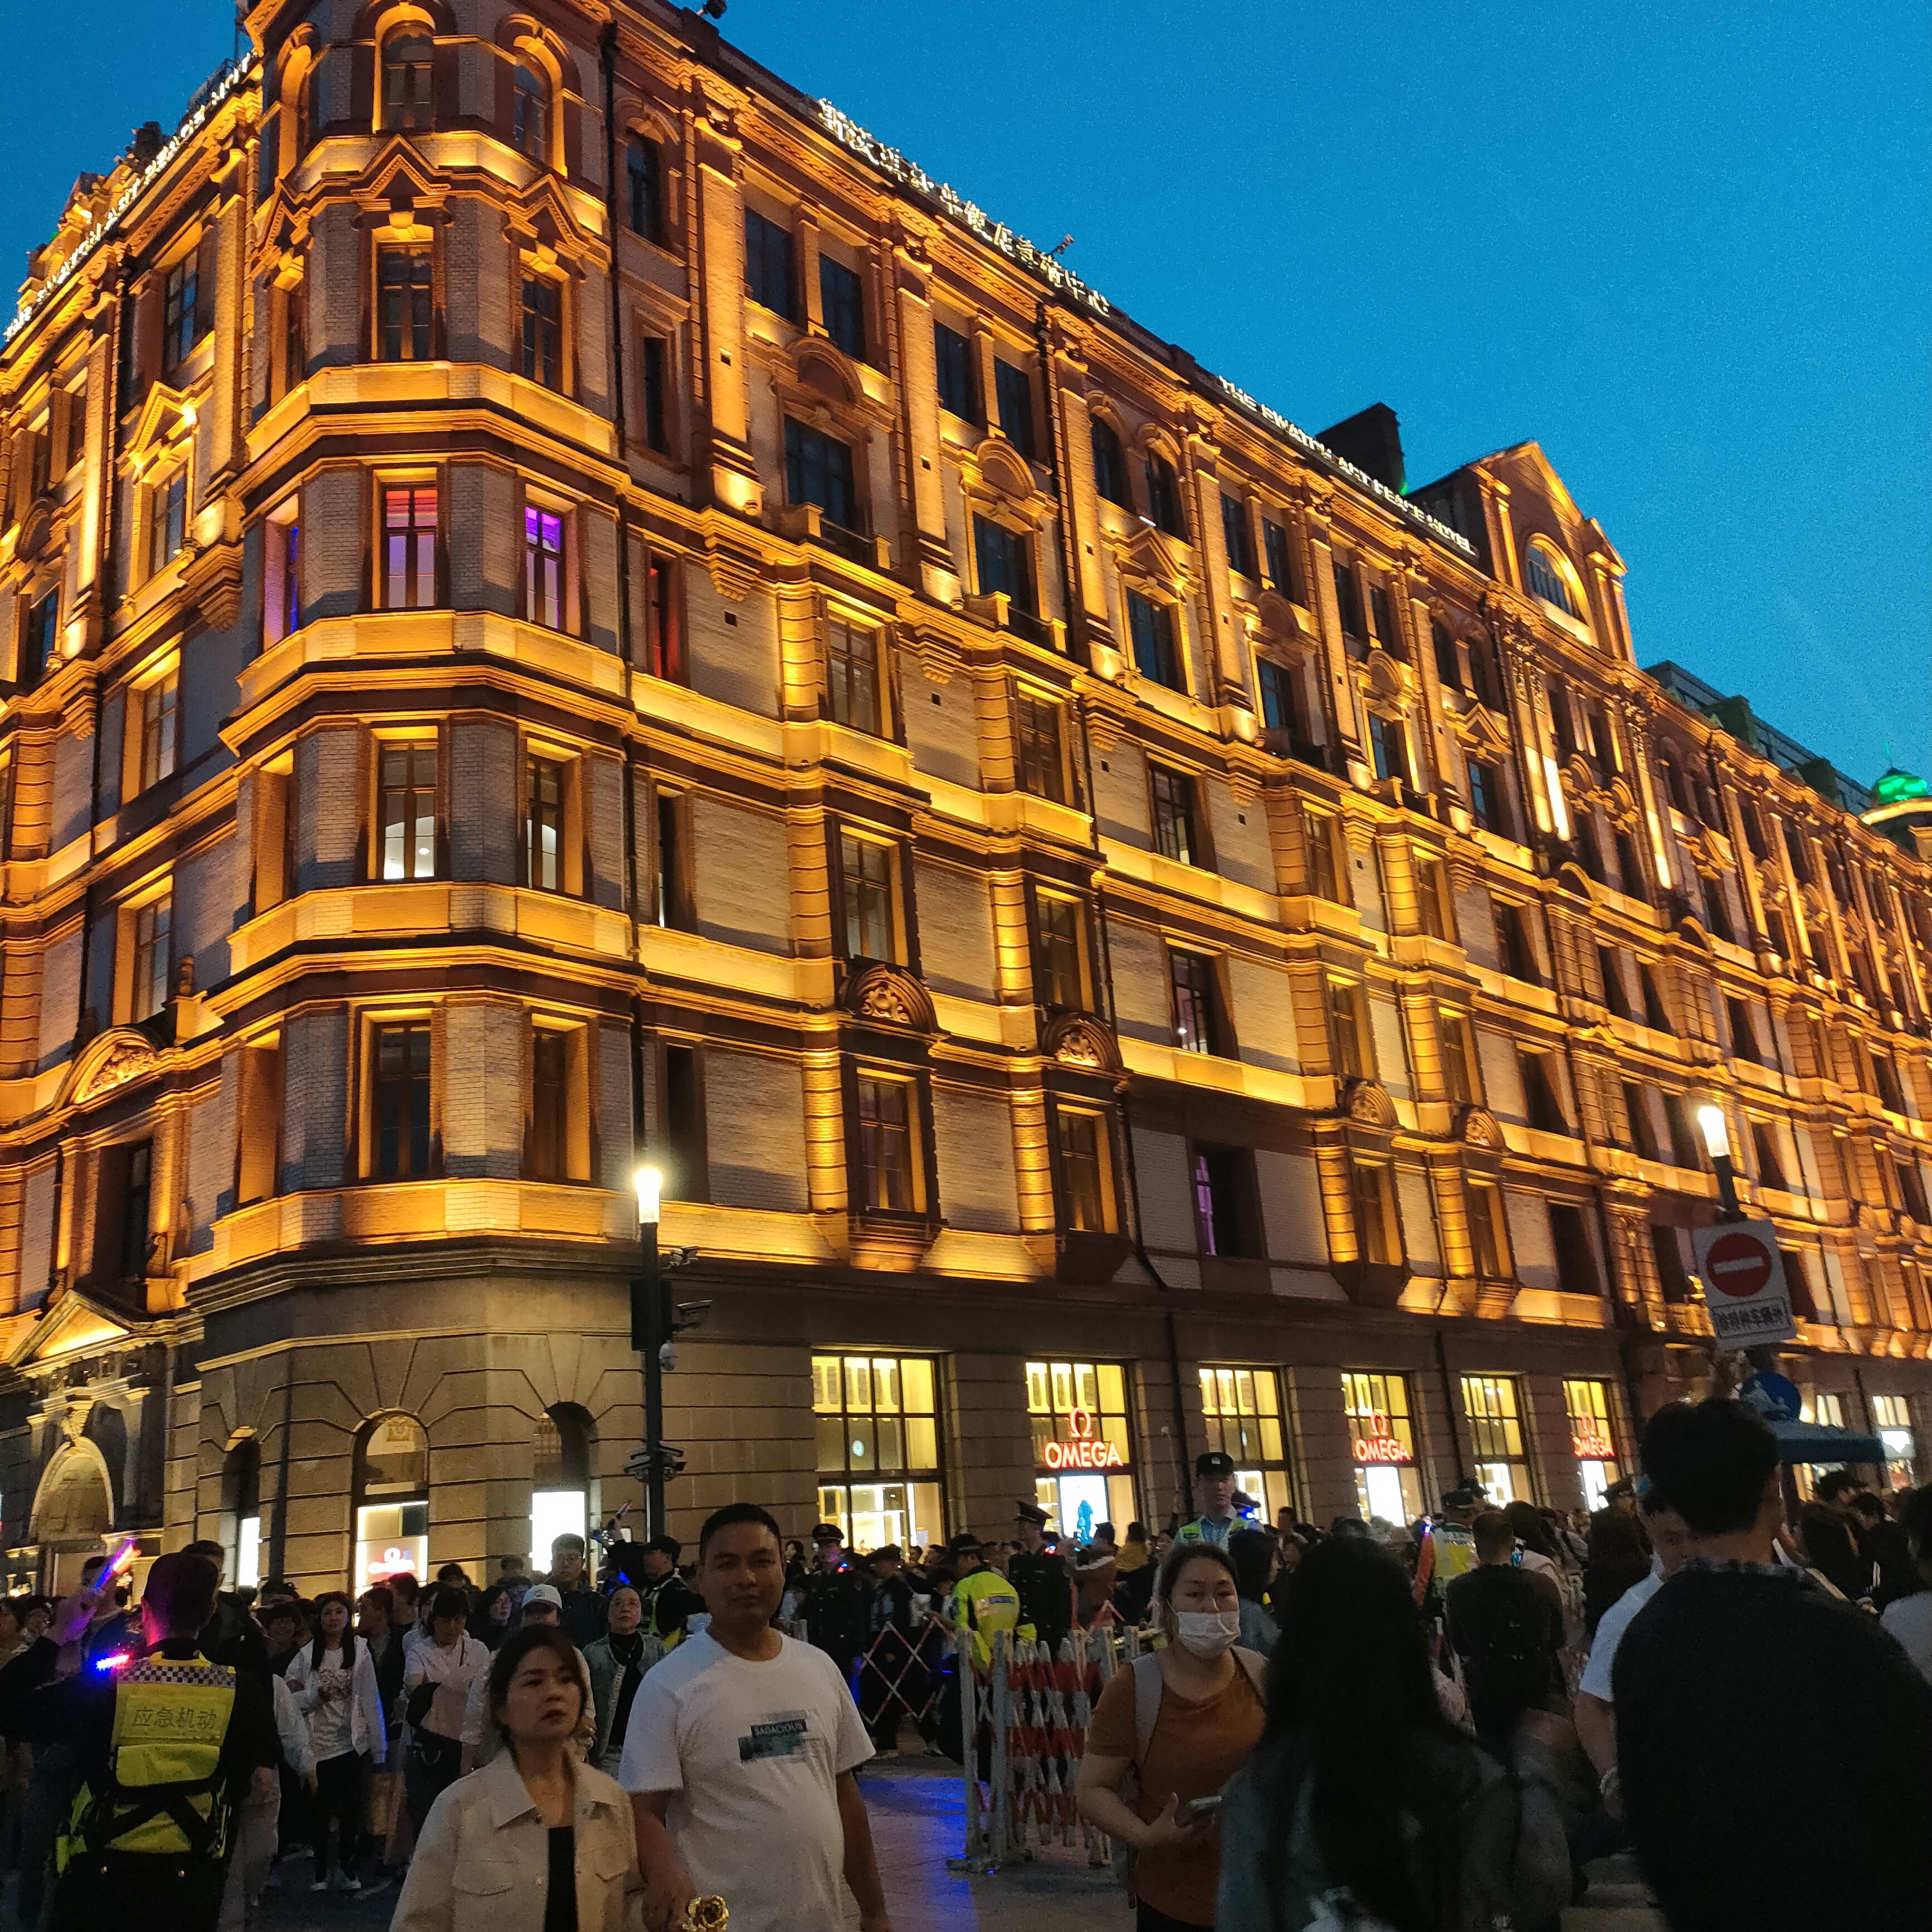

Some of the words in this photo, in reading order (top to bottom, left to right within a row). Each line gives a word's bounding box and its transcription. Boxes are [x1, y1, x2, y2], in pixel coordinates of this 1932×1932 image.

[1218, 375, 1258, 412] THE
[1261, 403, 1332, 461] SWATCH
[1338, 456, 1372, 487] ART
[1426, 514, 1476, 556] HOTEL
[1043, 1441, 1124, 1470] OMEGA
[1354, 1438, 1412, 1462] OMEGA
[131, 1706, 217, 1729] 应急机动
